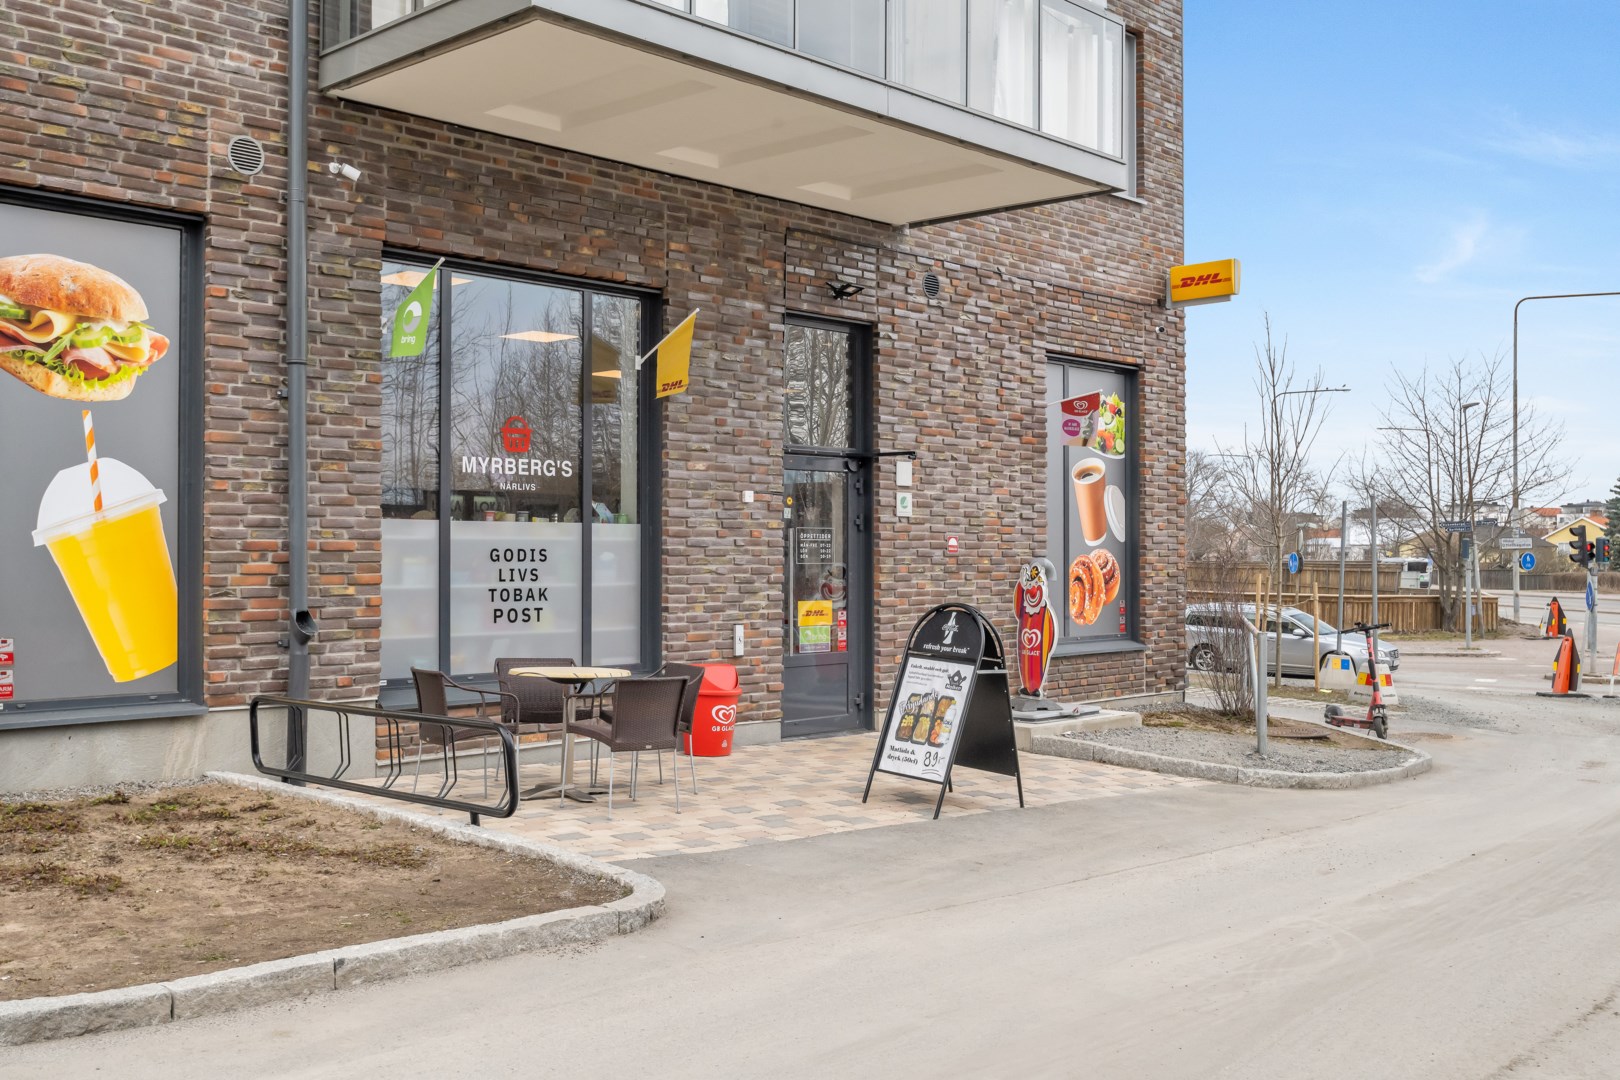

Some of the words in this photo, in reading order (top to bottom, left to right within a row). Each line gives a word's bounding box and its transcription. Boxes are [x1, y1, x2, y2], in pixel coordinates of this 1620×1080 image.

[1180, 273, 1223, 288] DHL
[400, 335, 416, 345] bring
[661, 379, 684, 392] DHL
[461, 455, 573, 477] MYRBERG'S
[489, 548, 548, 563] GODIS
[498, 567, 539, 582] LIVS
[488, 587, 549, 603] TOBAK
[493, 607, 544, 624] POST
[923, 642, 941, 651] refresh
